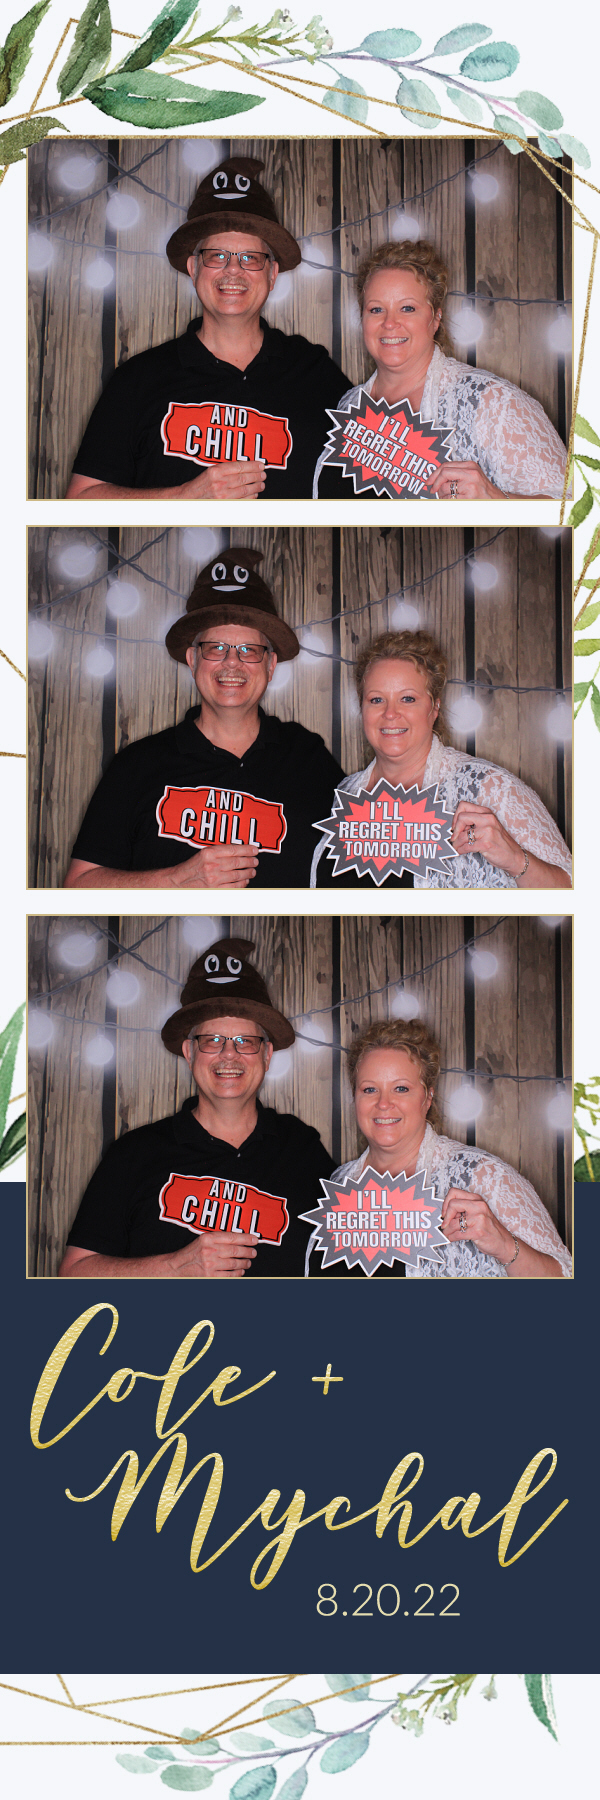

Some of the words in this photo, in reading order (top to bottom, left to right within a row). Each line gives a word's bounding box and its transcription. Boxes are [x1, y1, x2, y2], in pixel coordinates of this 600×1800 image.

[211, 405, 248, 428] AND
[378, 415, 410, 446] I'LL
[186, 425, 266, 464] CHILL
[343, 419, 401, 459] REGRET
[401, 449, 437, 480] THIS
[341, 439, 426, 495] TOMORROW
[205, 789, 243, 812] AND
[369, 801, 403, 820] I'LL
[180, 809, 260, 847] CHILL
[339, 821, 399, 840] REGRET
[404, 823, 442, 841] THIS
[345, 841, 437, 859] TOMORROW
[209, 1179, 247, 1203] AND
[357, 1190, 392, 1209] I'LL
[181, 1195, 261, 1238] CHILL
[326, 1211, 388, 1230] REGRET
[393, 1211, 432, 1230] THIS
[333, 1231, 428, 1248] TOMORROW
